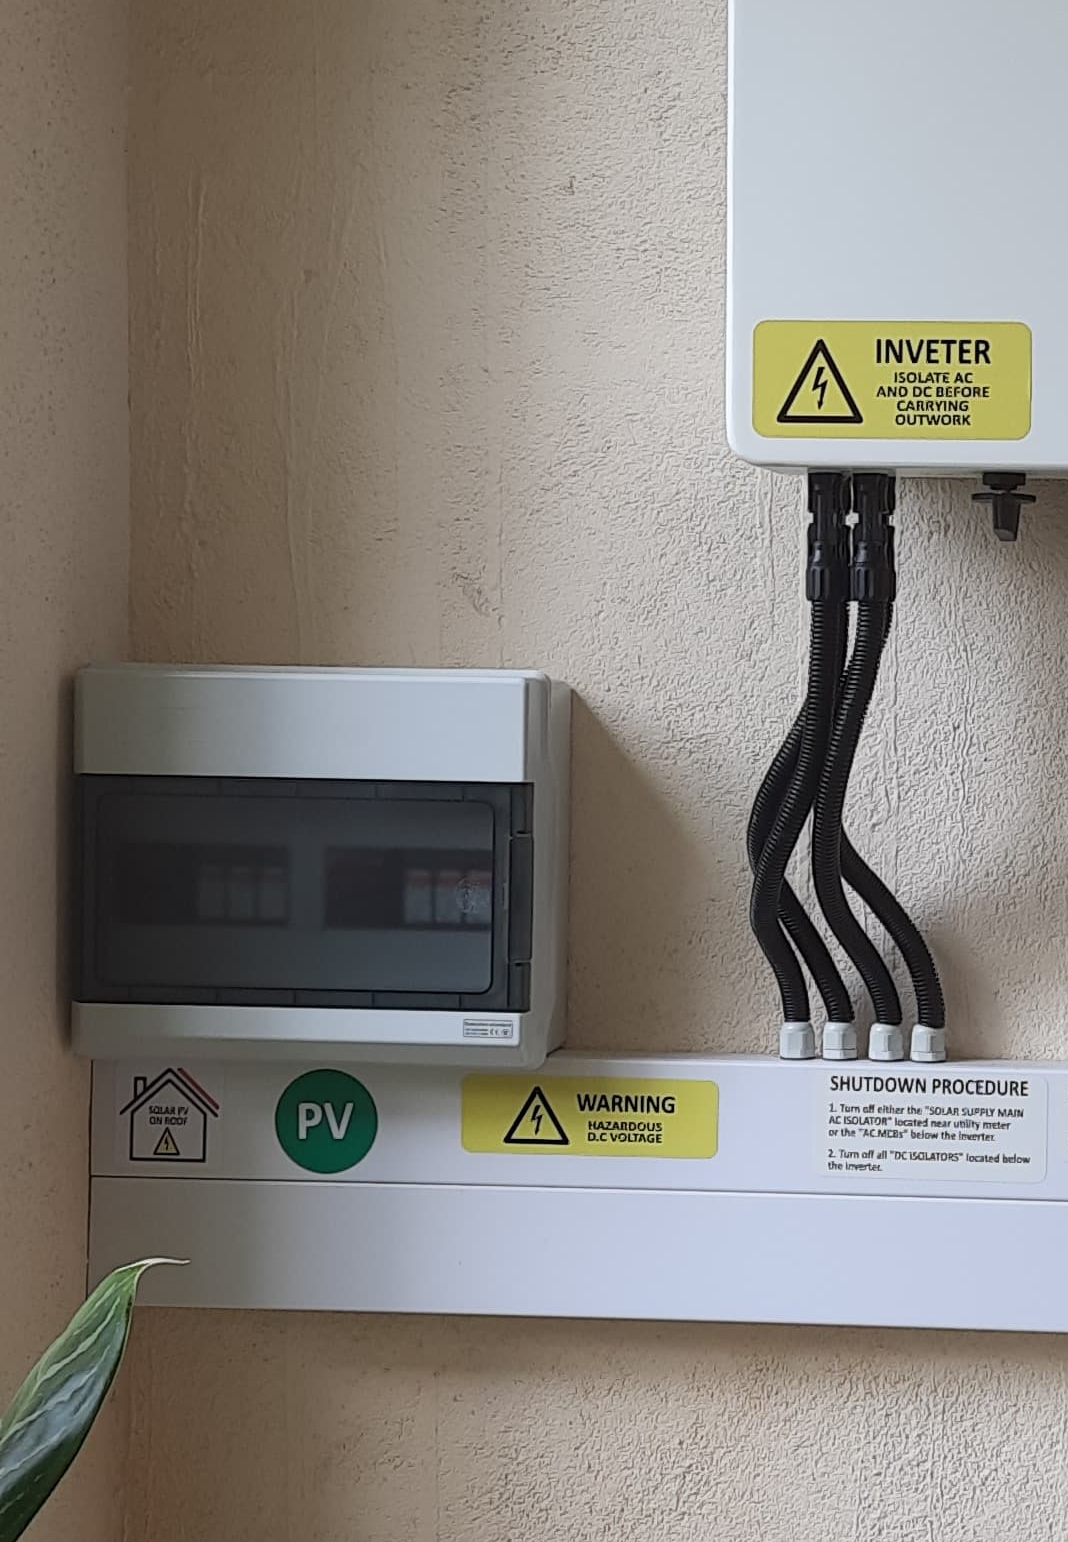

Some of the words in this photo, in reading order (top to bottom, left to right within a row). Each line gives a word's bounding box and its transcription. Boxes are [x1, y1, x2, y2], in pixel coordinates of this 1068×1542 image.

[876, 338, 991, 364] INVETER
[894, 371, 950, 384] ISOLATE
[953, 372, 973, 384] AC
[876, 386, 908, 398] AND
[912, 386, 932, 398] DC
[936, 386, 990, 398] BEFORE
[896, 400, 969, 412] CARRYING
[895, 414, 971, 426] OUTWORK
[829, 1075, 927, 1094] SHUTDOWN
[931, 1078, 1029, 1097] PROCEDURE
[577, 1093, 676, 1114] WARNING
[149, 1105, 176, 1115] SOLAR
[178, 1106, 189, 1116] PV
[840, 1103, 860, 1113] Turn
[862, 1104, 875, 1114] off
[877, 1105, 905, 1115] either
[907, 1105, 923, 1115] the
[925, 1106, 959, 1116] "SOLAR
[961, 1107, 995, 1117] SUPPLY
[998, 1108, 1024, 1118] MAIN
[149, 1116, 162, 1125] ON
[165, 1116, 188, 1126] ROOF
[298, 1102, 354, 1140] PV
[588, 1121, 663, 1132] HAZARDOUS
[829, 1115, 841, 1125] AC
[843, 1116, 892, 1126] ISOLATOR"
[895, 1117, 928, 1127] located
[931, 1120, 951, 1128] near
[954, 1119, 980, 1131] utility
[983, 1121, 1011, 1130] meter
[588, 1132, 607, 1142] D.C
[610, 1133, 663, 1143] VOLTAGE
[828, 1129, 839, 1137] or
[841, 1128, 856, 1137] the
[911, 1129, 938, 1140] below
[941, 1131, 956, 1140] the
[839, 1149, 860, 1159] Turn
[861, 1150, 875, 1159] off
[876, 1150, 888, 1160] all
[966, 1153, 1000, 1163] located
[1002, 1153, 1031, 1164] below
[828, 1161, 843, 1171] the
